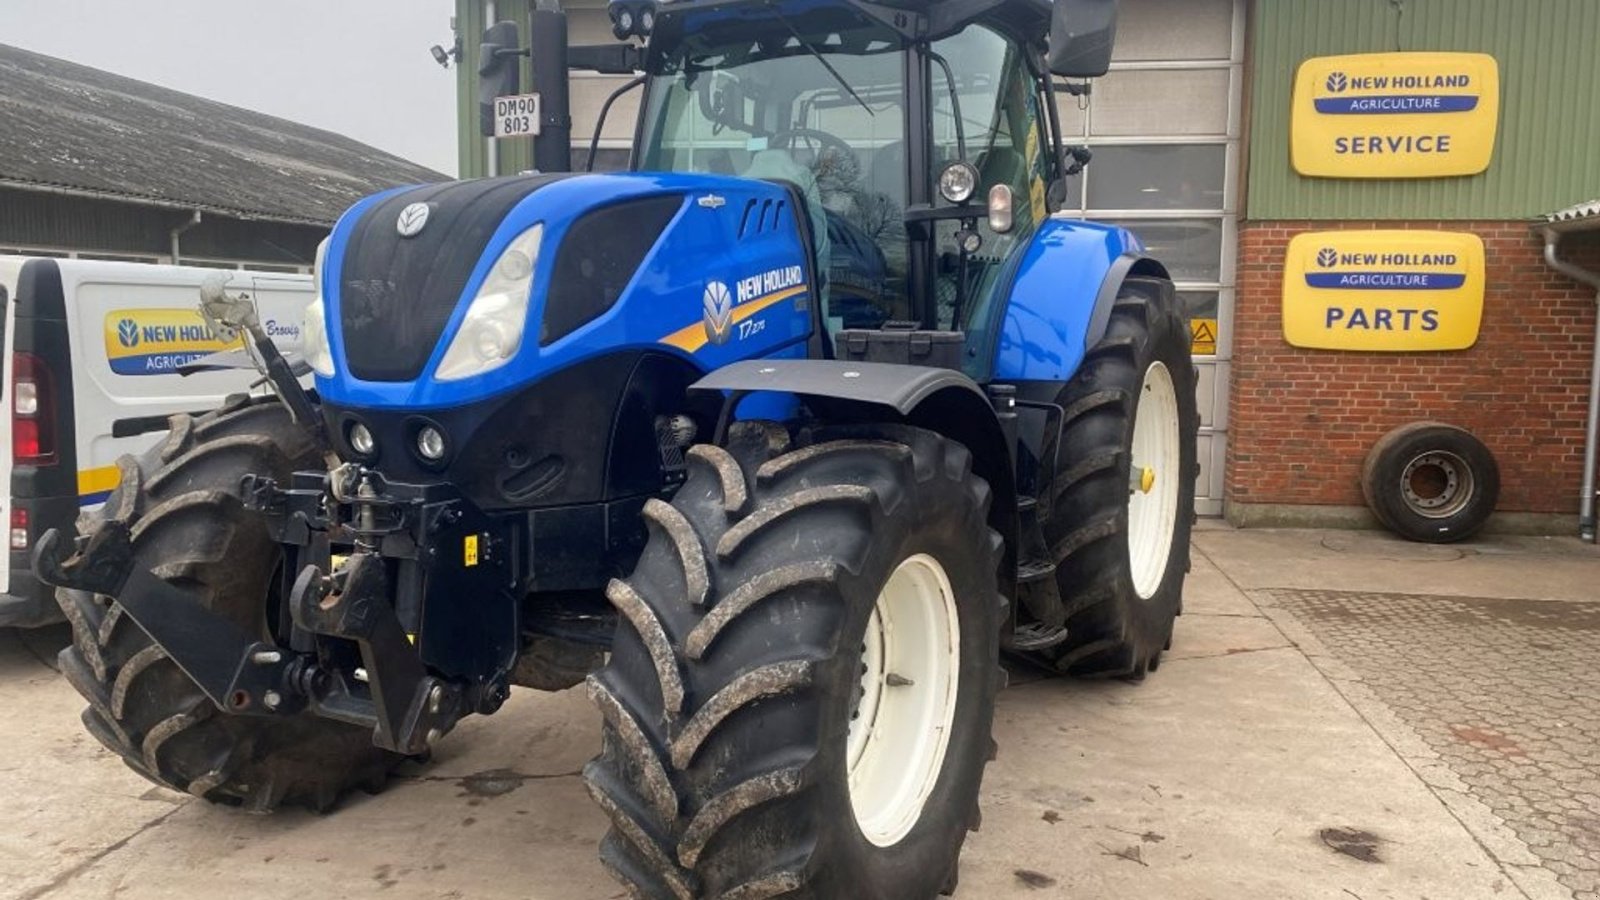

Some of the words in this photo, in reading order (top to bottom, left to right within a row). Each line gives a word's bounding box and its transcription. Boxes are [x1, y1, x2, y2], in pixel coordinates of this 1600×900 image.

[1351, 77, 1388, 90] NEW
[1392, 75, 1470, 89] HOLLAND
[1350, 98, 1441, 110] AGRICULTURE
[504, 116, 530, 134] 803
[1335, 136, 1451, 154] SERVICE
[1341, 253, 1377, 266] NEW
[1381, 253, 1457, 266] HOLLAND
[737, 274, 762, 303] NEW
[764, 265, 802, 293] HOLLAND
[1340, 275, 1429, 286] AGRICULTURE
[1325, 308, 1440, 331] PARTS
[143, 325, 176, 343] NEW
